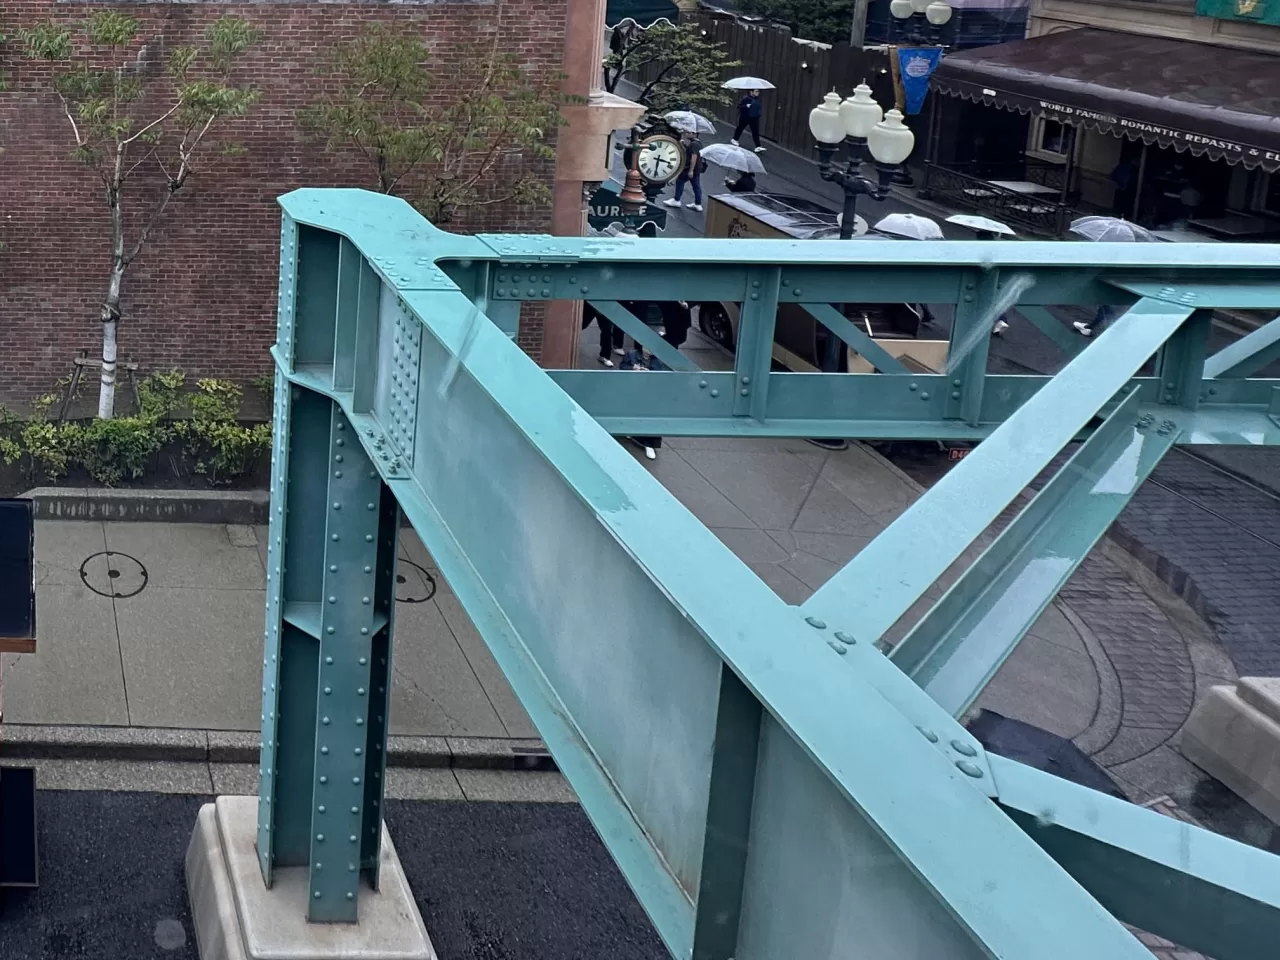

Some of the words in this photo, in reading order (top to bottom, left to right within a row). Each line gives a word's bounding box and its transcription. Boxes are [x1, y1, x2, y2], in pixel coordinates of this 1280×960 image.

[1040, 100, 1073, 114] WORLD
[1075, 108, 1118, 124] FAMOUS
[1120, 118, 1181, 139] ROMANTIC
[1185, 132, 1243, 153] REPASTS
[1248, 147, 1260, 157] &
[1266, 151, 1280, 162] EL
